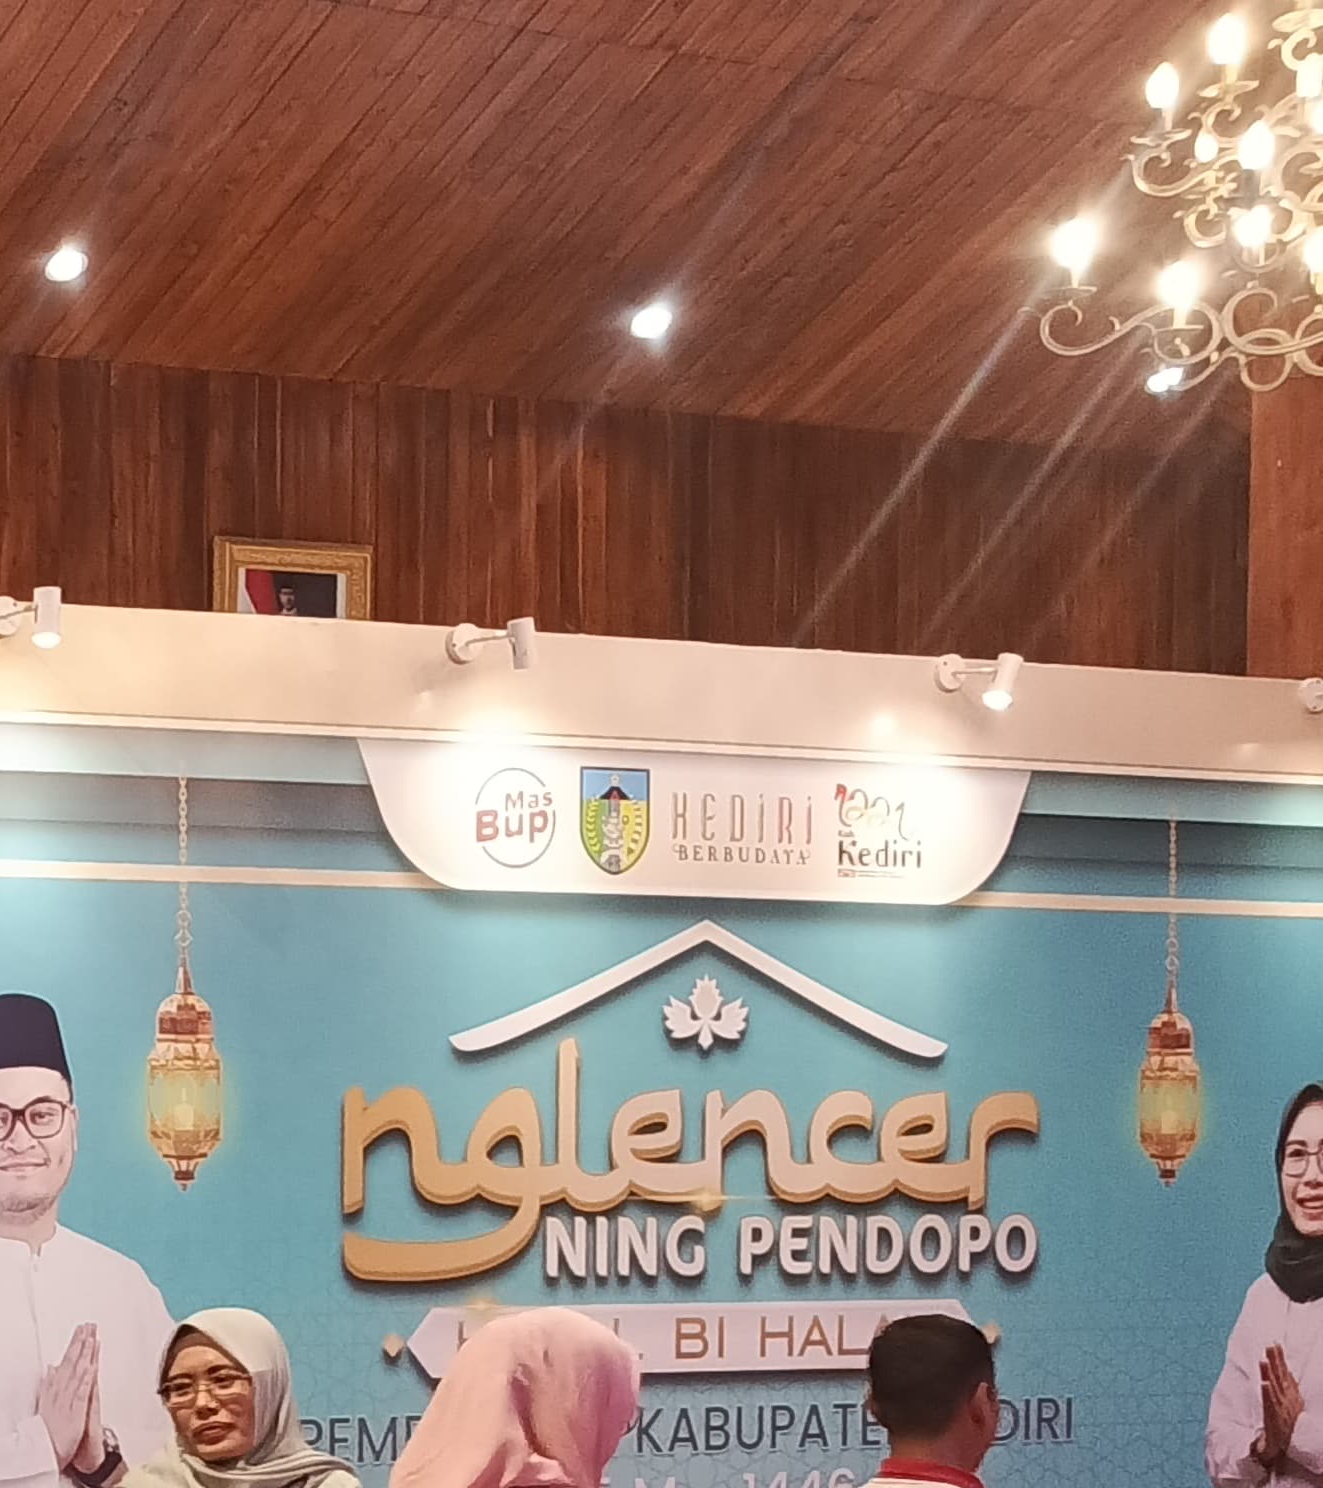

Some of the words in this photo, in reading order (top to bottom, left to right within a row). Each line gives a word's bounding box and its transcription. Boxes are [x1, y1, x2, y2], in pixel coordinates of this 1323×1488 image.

[505, 791, 553, 811] Mas
[475, 809, 549, 843] Bup
[672, 843, 811, 866] BERBUDAYA
[838, 839, 922, 869] Kediri
[342, 1037, 1040, 1281] nglencer
[545, 1215, 706, 1278] NING
[738, 1214, 1038, 1276] PENDOPO
[674, 1316, 725, 1359] BI
[636, 1402, 889, 1453] KABUPATE
[991, 1396, 1073, 1442] DIRI
